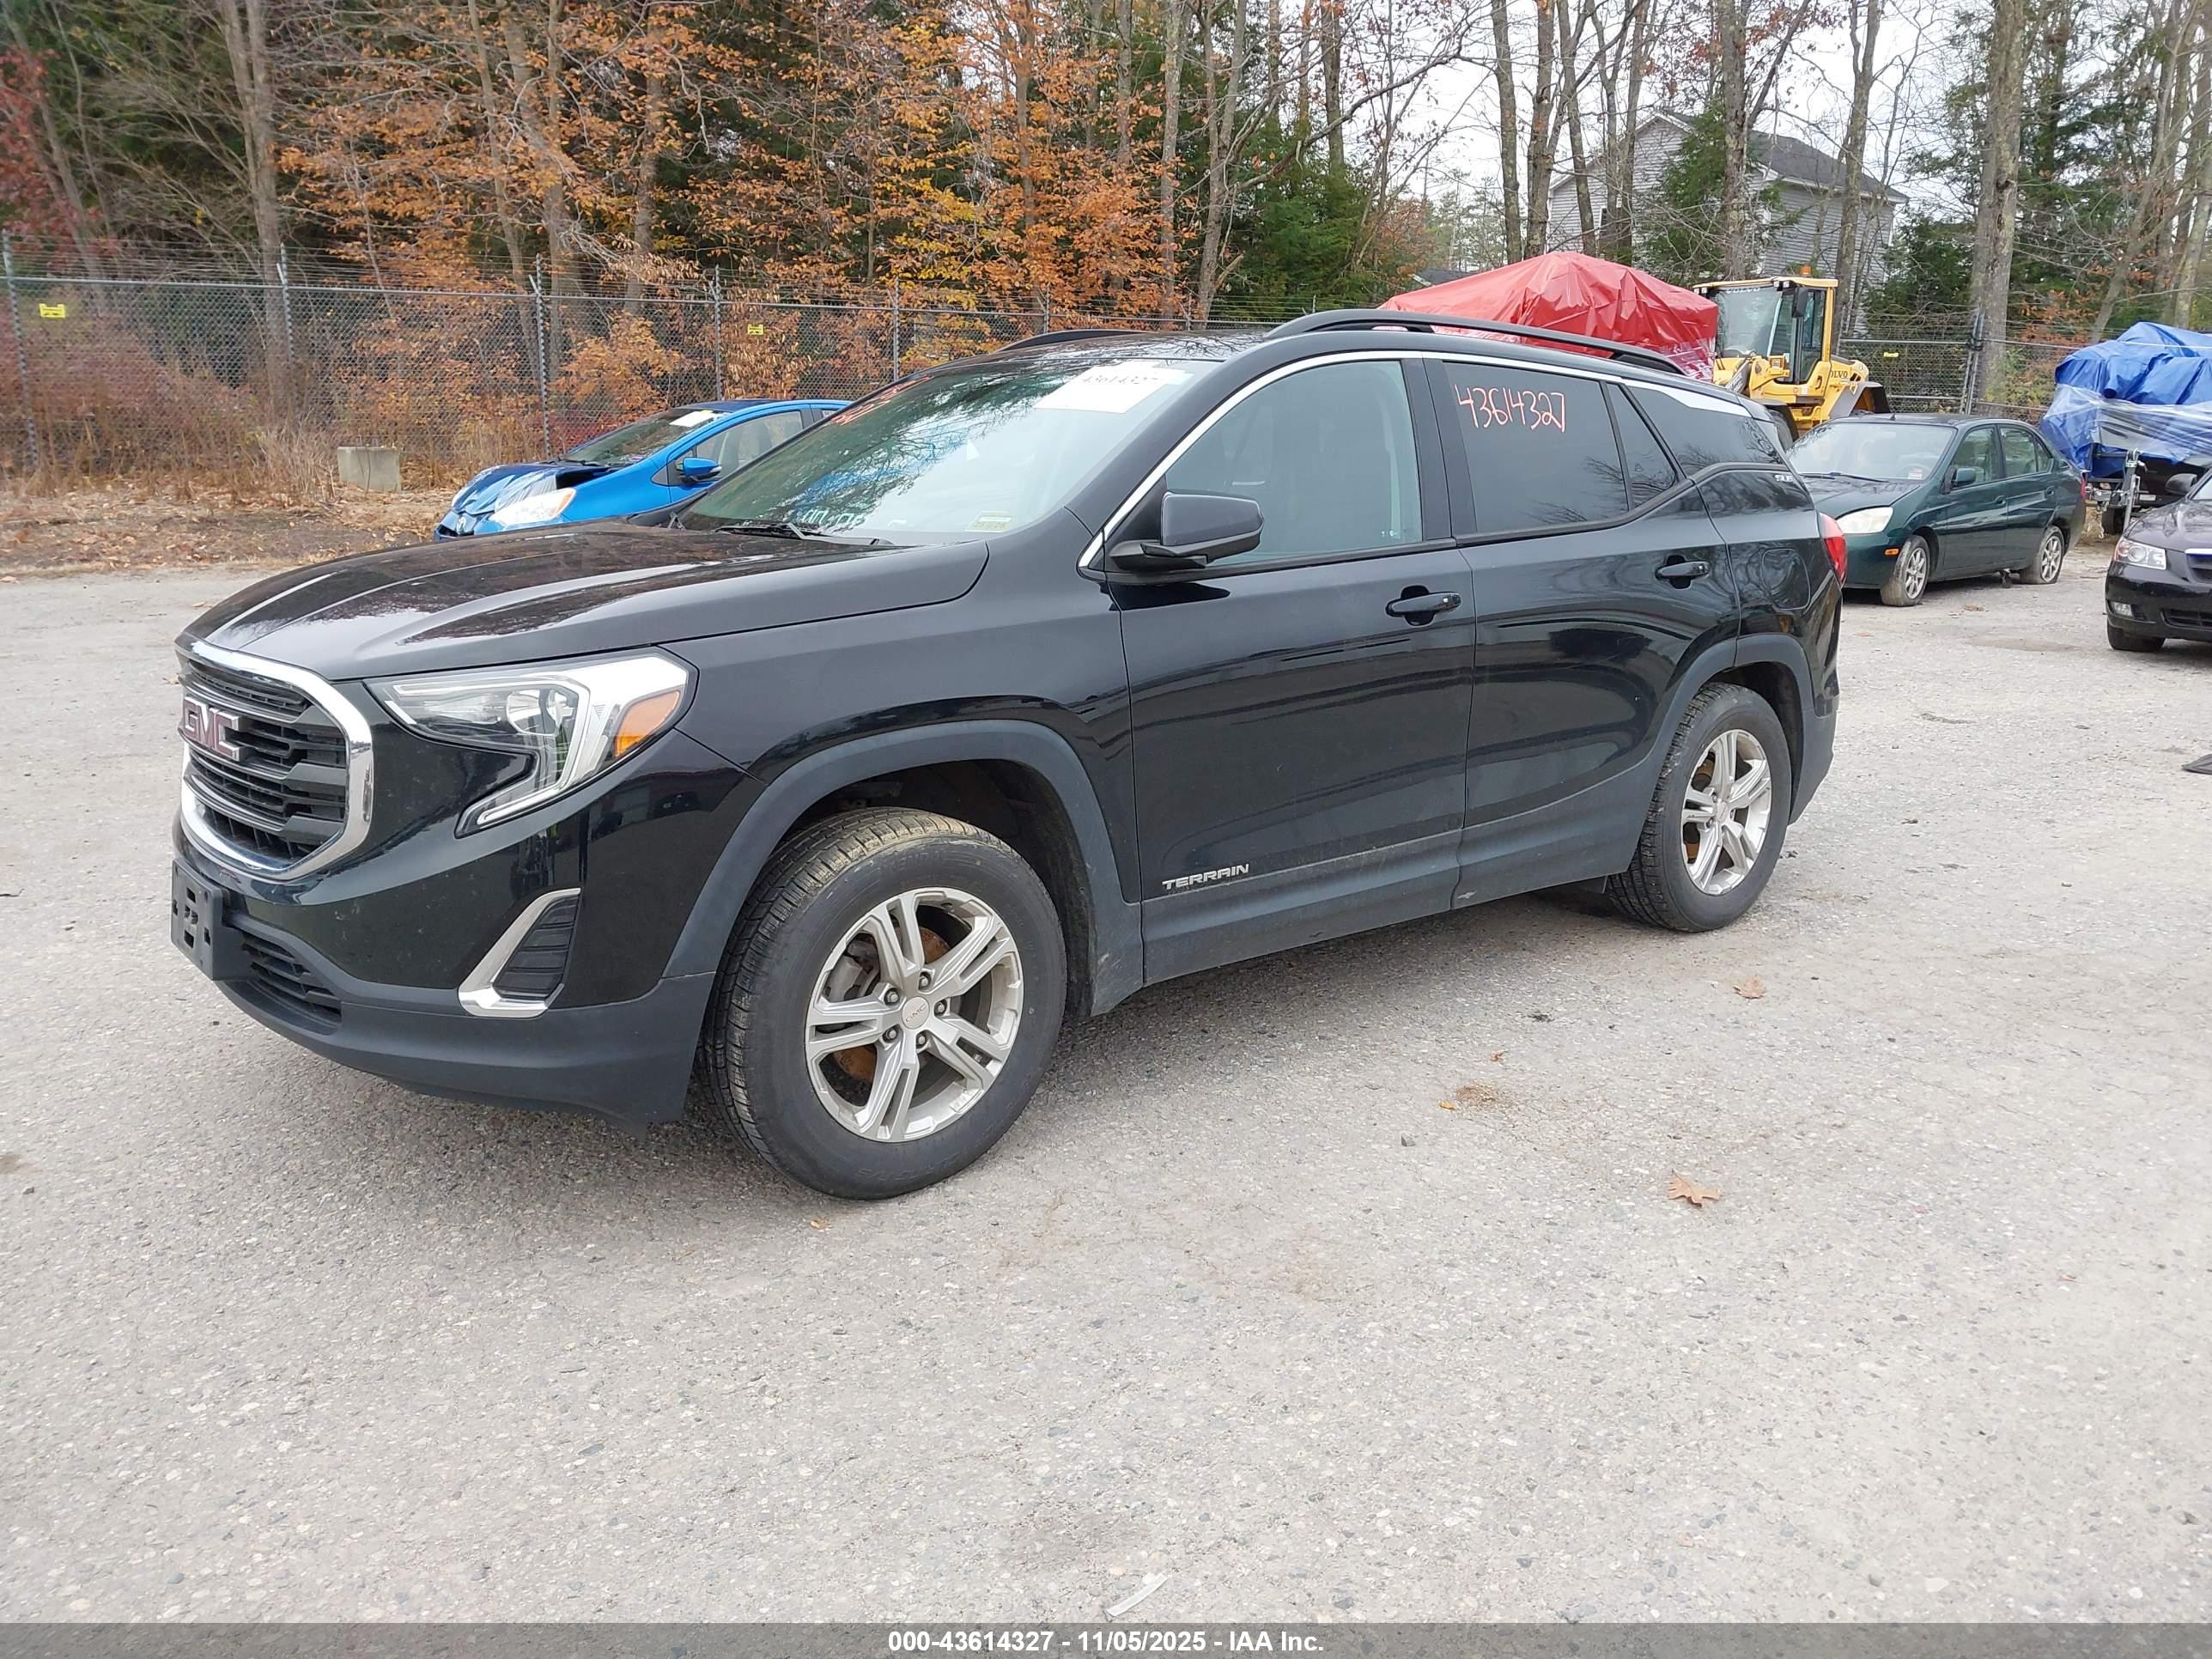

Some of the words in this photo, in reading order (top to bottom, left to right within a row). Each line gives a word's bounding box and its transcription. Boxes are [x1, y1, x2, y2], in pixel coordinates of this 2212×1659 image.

[1831, 370, 1848, 379] OLVO
[1454, 384, 1565, 433] 43614327
[182, 696, 240, 762] GMC
[1162, 863, 1249, 890] TERRAIN
